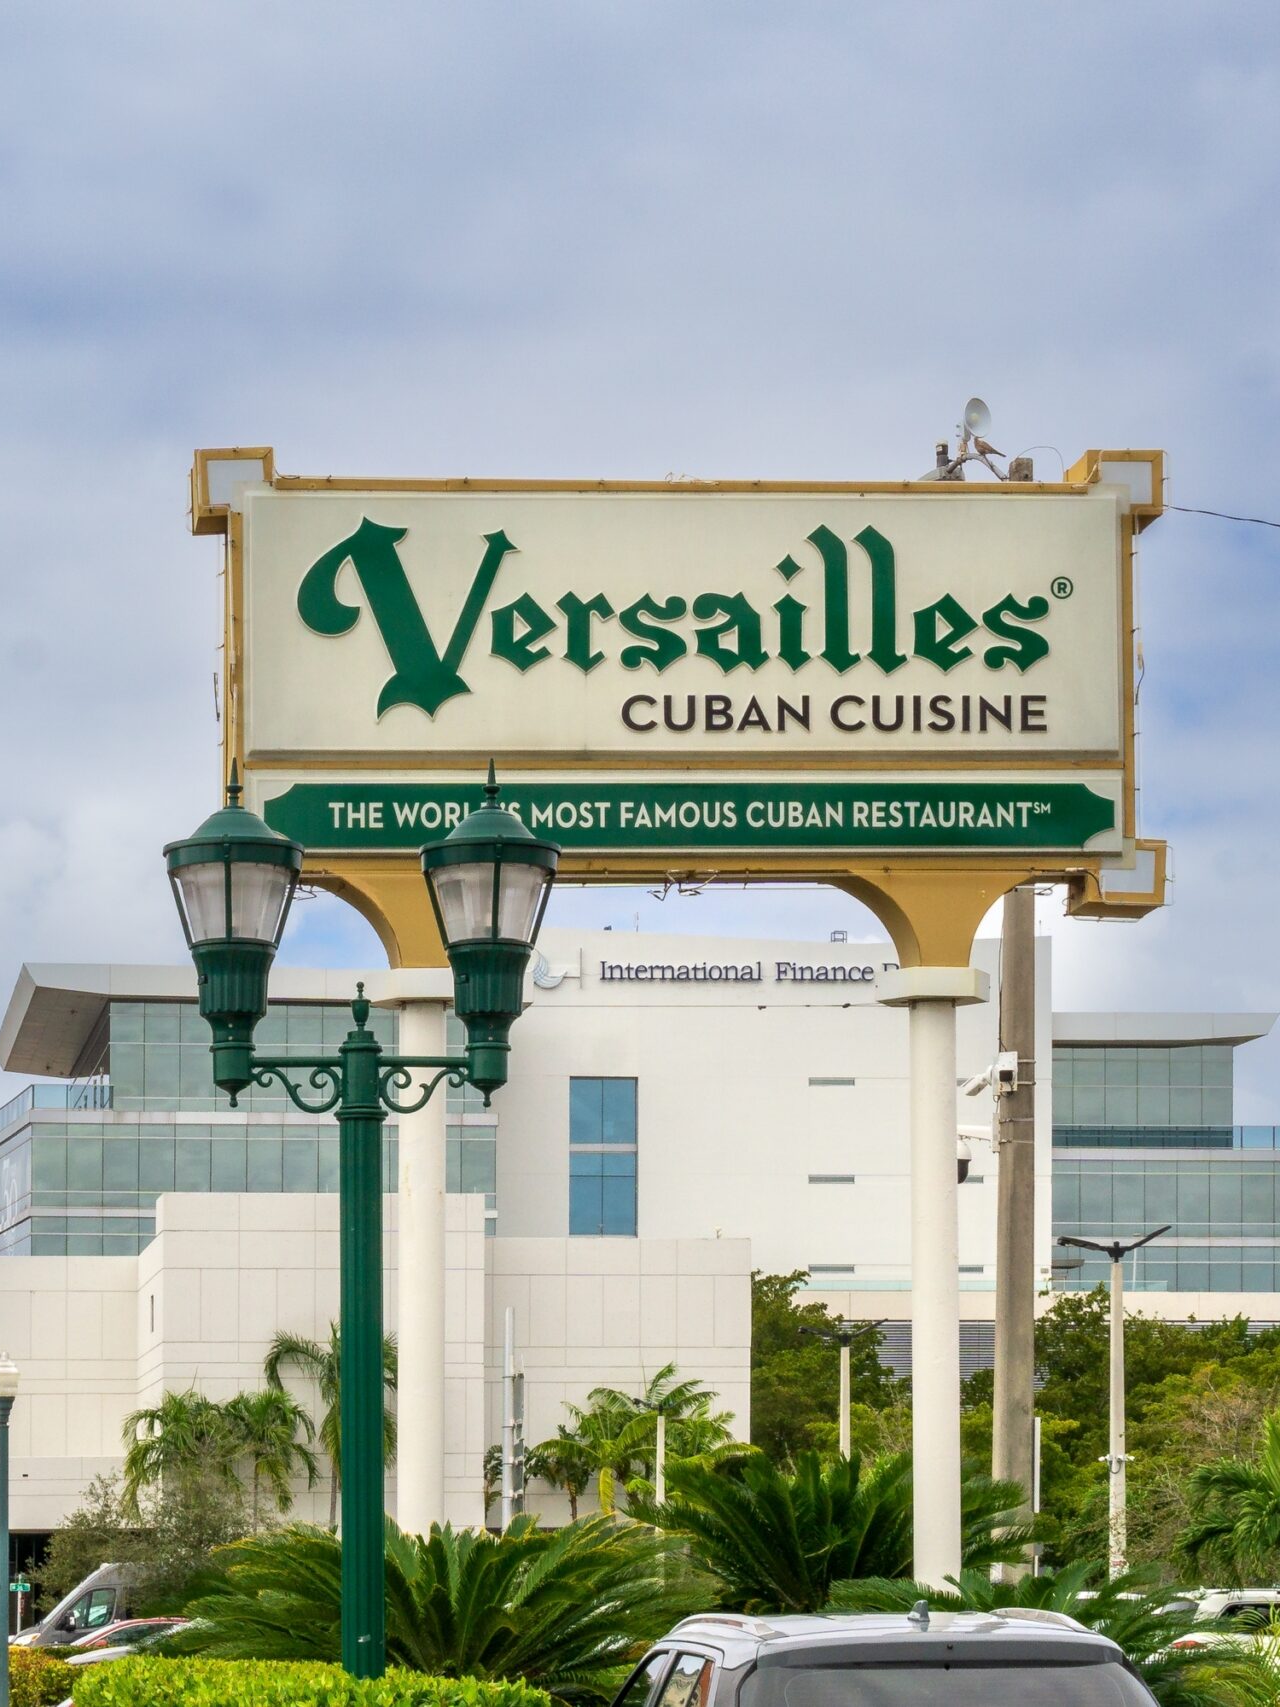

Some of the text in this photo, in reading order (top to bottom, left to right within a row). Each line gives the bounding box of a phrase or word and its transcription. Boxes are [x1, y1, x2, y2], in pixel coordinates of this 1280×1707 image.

[620, 694, 1048, 732] CUBAN CUISINE
[328, 802, 384, 829] THE
[531, 801, 611, 828] MOST
[619, 801, 737, 828] FAMOUS
[745, 801, 843, 828] CUBAN
[599, 960, 762, 982] International
[775, 961, 874, 982] Finance
